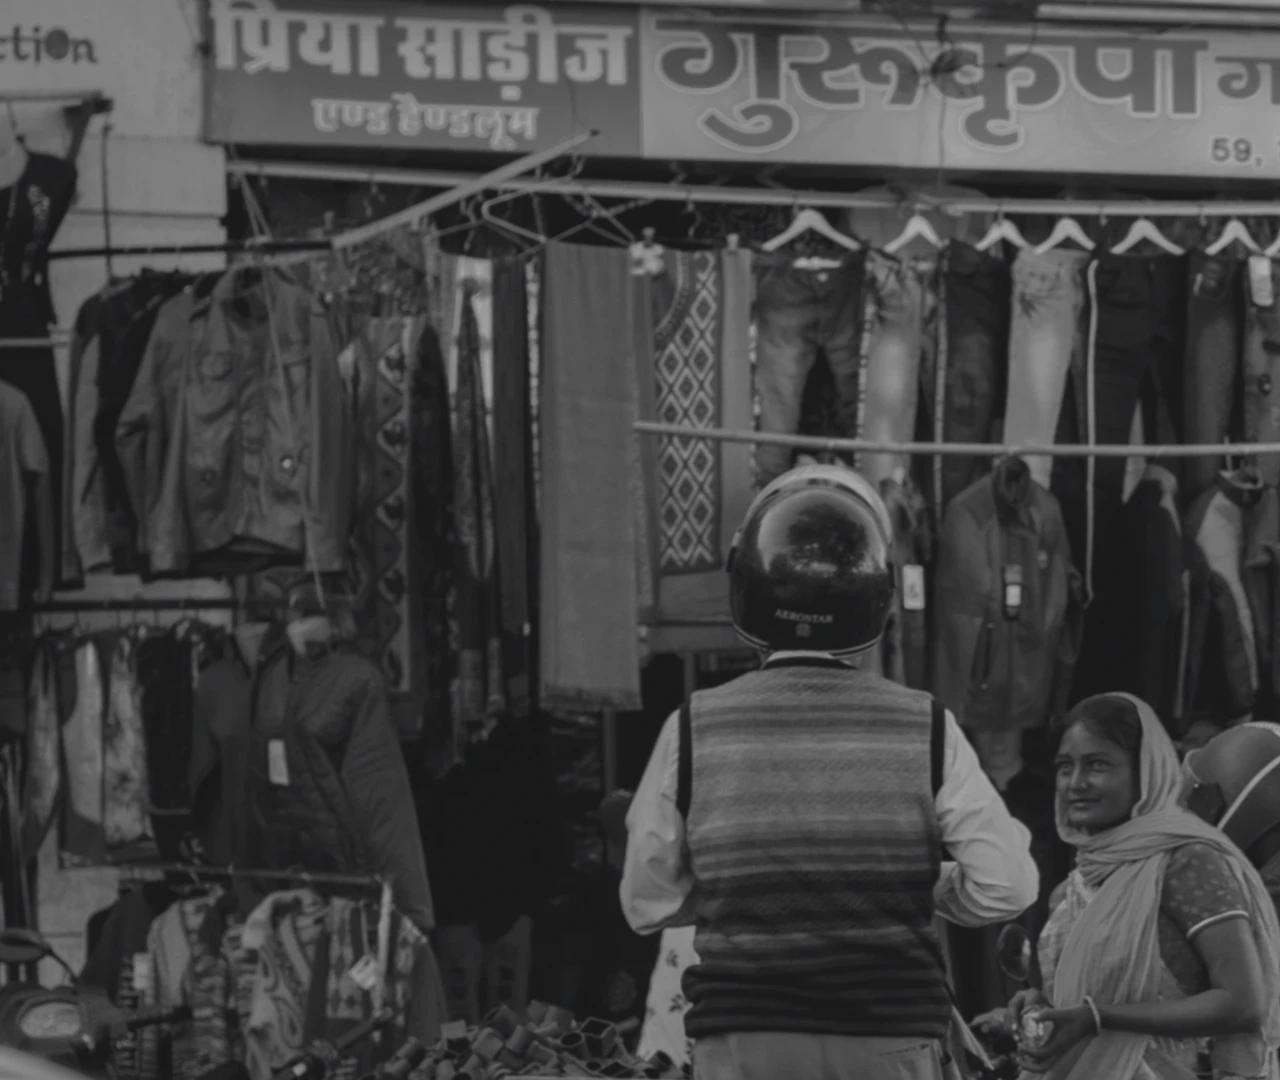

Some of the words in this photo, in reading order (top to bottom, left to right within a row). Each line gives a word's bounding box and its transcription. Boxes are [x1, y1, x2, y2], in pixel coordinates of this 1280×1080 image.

[0, 25, 99, 65] tion
[209, 2, 386, 75] प्रिया
[1210, 136, 1263, 169] 59,
